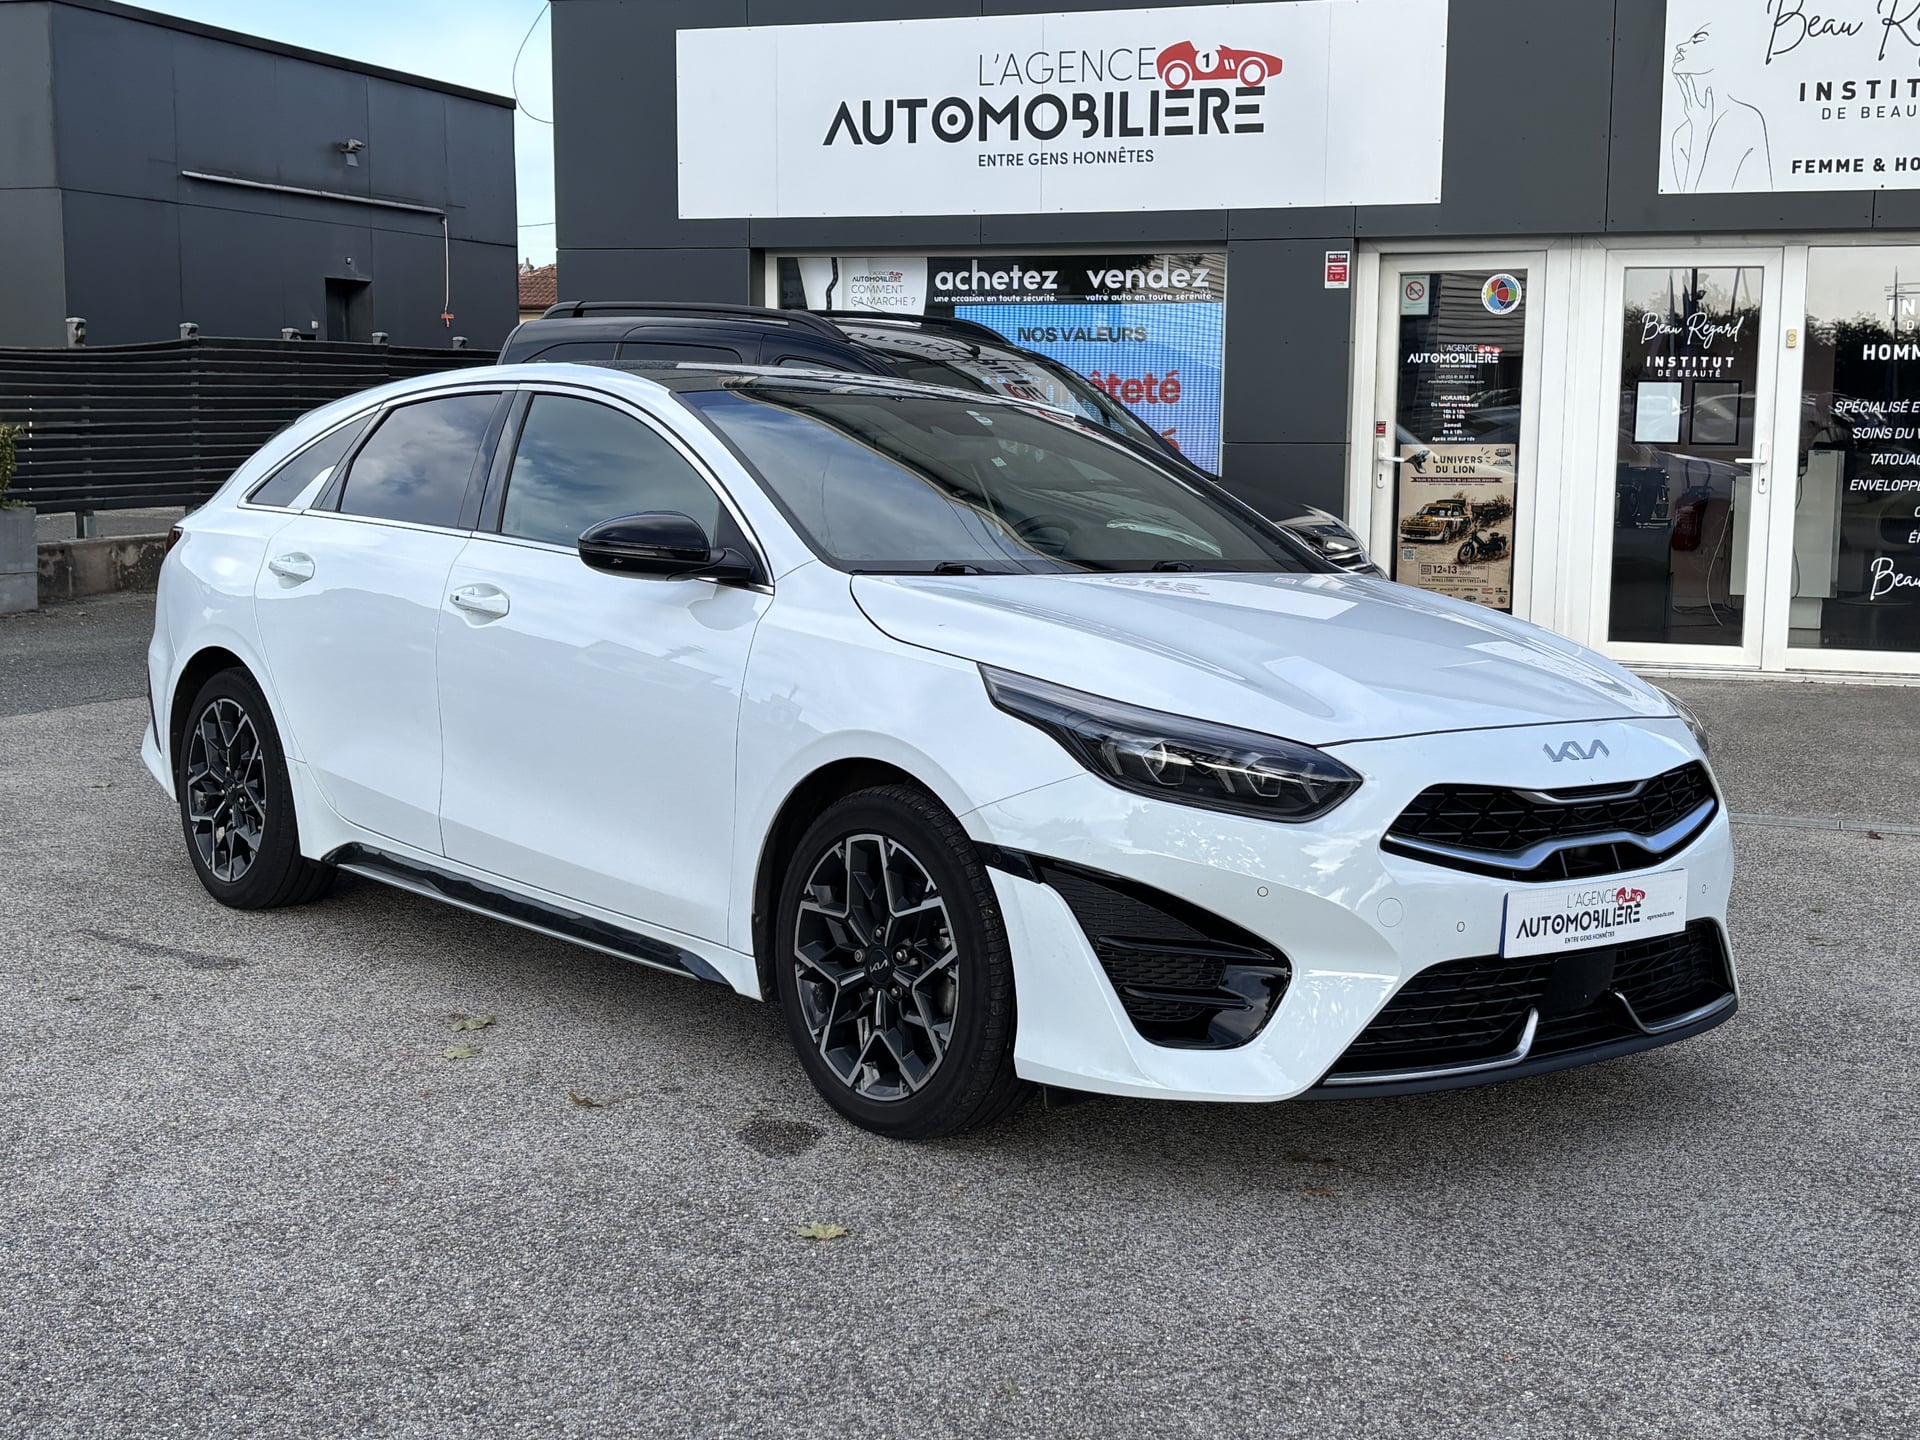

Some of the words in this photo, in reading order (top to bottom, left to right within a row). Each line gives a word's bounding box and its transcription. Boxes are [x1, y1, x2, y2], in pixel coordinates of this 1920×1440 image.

[1765, 0, 1864, 66] Beau
[979, 47, 1157, 87] L'AGENCE
[1201, 52, 1211, 69] 1
[1799, 78, 1920, 102] INSTIT
[822, 85, 1266, 146] AUTOMOBILIERE
[1821, 106, 1847, 121] DE
[1861, 104, 1917, 119] BEAU
[977, 153, 1024, 167] ENTRE
[1028, 152, 1069, 166] GENS
[1072, 146, 1155, 165] HONNÊTES
[1791, 158, 1864, 174] FEMME
[1872, 157, 1886, 173] &
[1894, 156, 1920, 172] HO
[934, 259, 1059, 291] achetez
[1086, 255, 1210, 290] vendez
[850, 284, 904, 294] COMMENT
[951, 293, 985, 302] occasion
[999, 293, 1021, 302] toute
[1023, 292, 1058, 302] sécurité.
[1085, 293, 1109, 302] votre
[1110, 293, 1132, 301] auto
[1134, 293, 1146, 301] en
[1148, 292, 1173, 301] toute
[1175, 291, 1215, 301] sérénité.
[866, 296, 909, 306] MARCHE
[1017, 326, 1058, 343] NOS
[1061, 326, 1147, 343] VALEURS
[1640, 312, 1683, 345] Beau
[1686, 312, 1745, 349] Regard
[1440, 343, 1478, 353] L'AGENCE
[1407, 352, 1500, 364] AUTOMOBILIERE
[1646, 355, 1735, 368] INSTITUT
[1657, 369, 1671, 377] DE
[1677, 367, 1721, 378] BEAUTÉ
[1834, 398, 1910, 414] SPÉCIALISÉ
[1852, 426, 1893, 440] SOINS
[1894, 426, 1915, 440] DU
[1435, 465, 1449, 474] DU
[1452, 465, 1476, 474] LION
[1907, 529, 1920, 544] É
[1542, 738, 1610, 763] KIA
[1566, 887, 1617, 909] L'AGENCE
[1515, 903, 1642, 939] AUTOMOBILIERE
[1564, 936, 1579, 944] ENTRE
[1580, 934, 1592, 943] GENS
